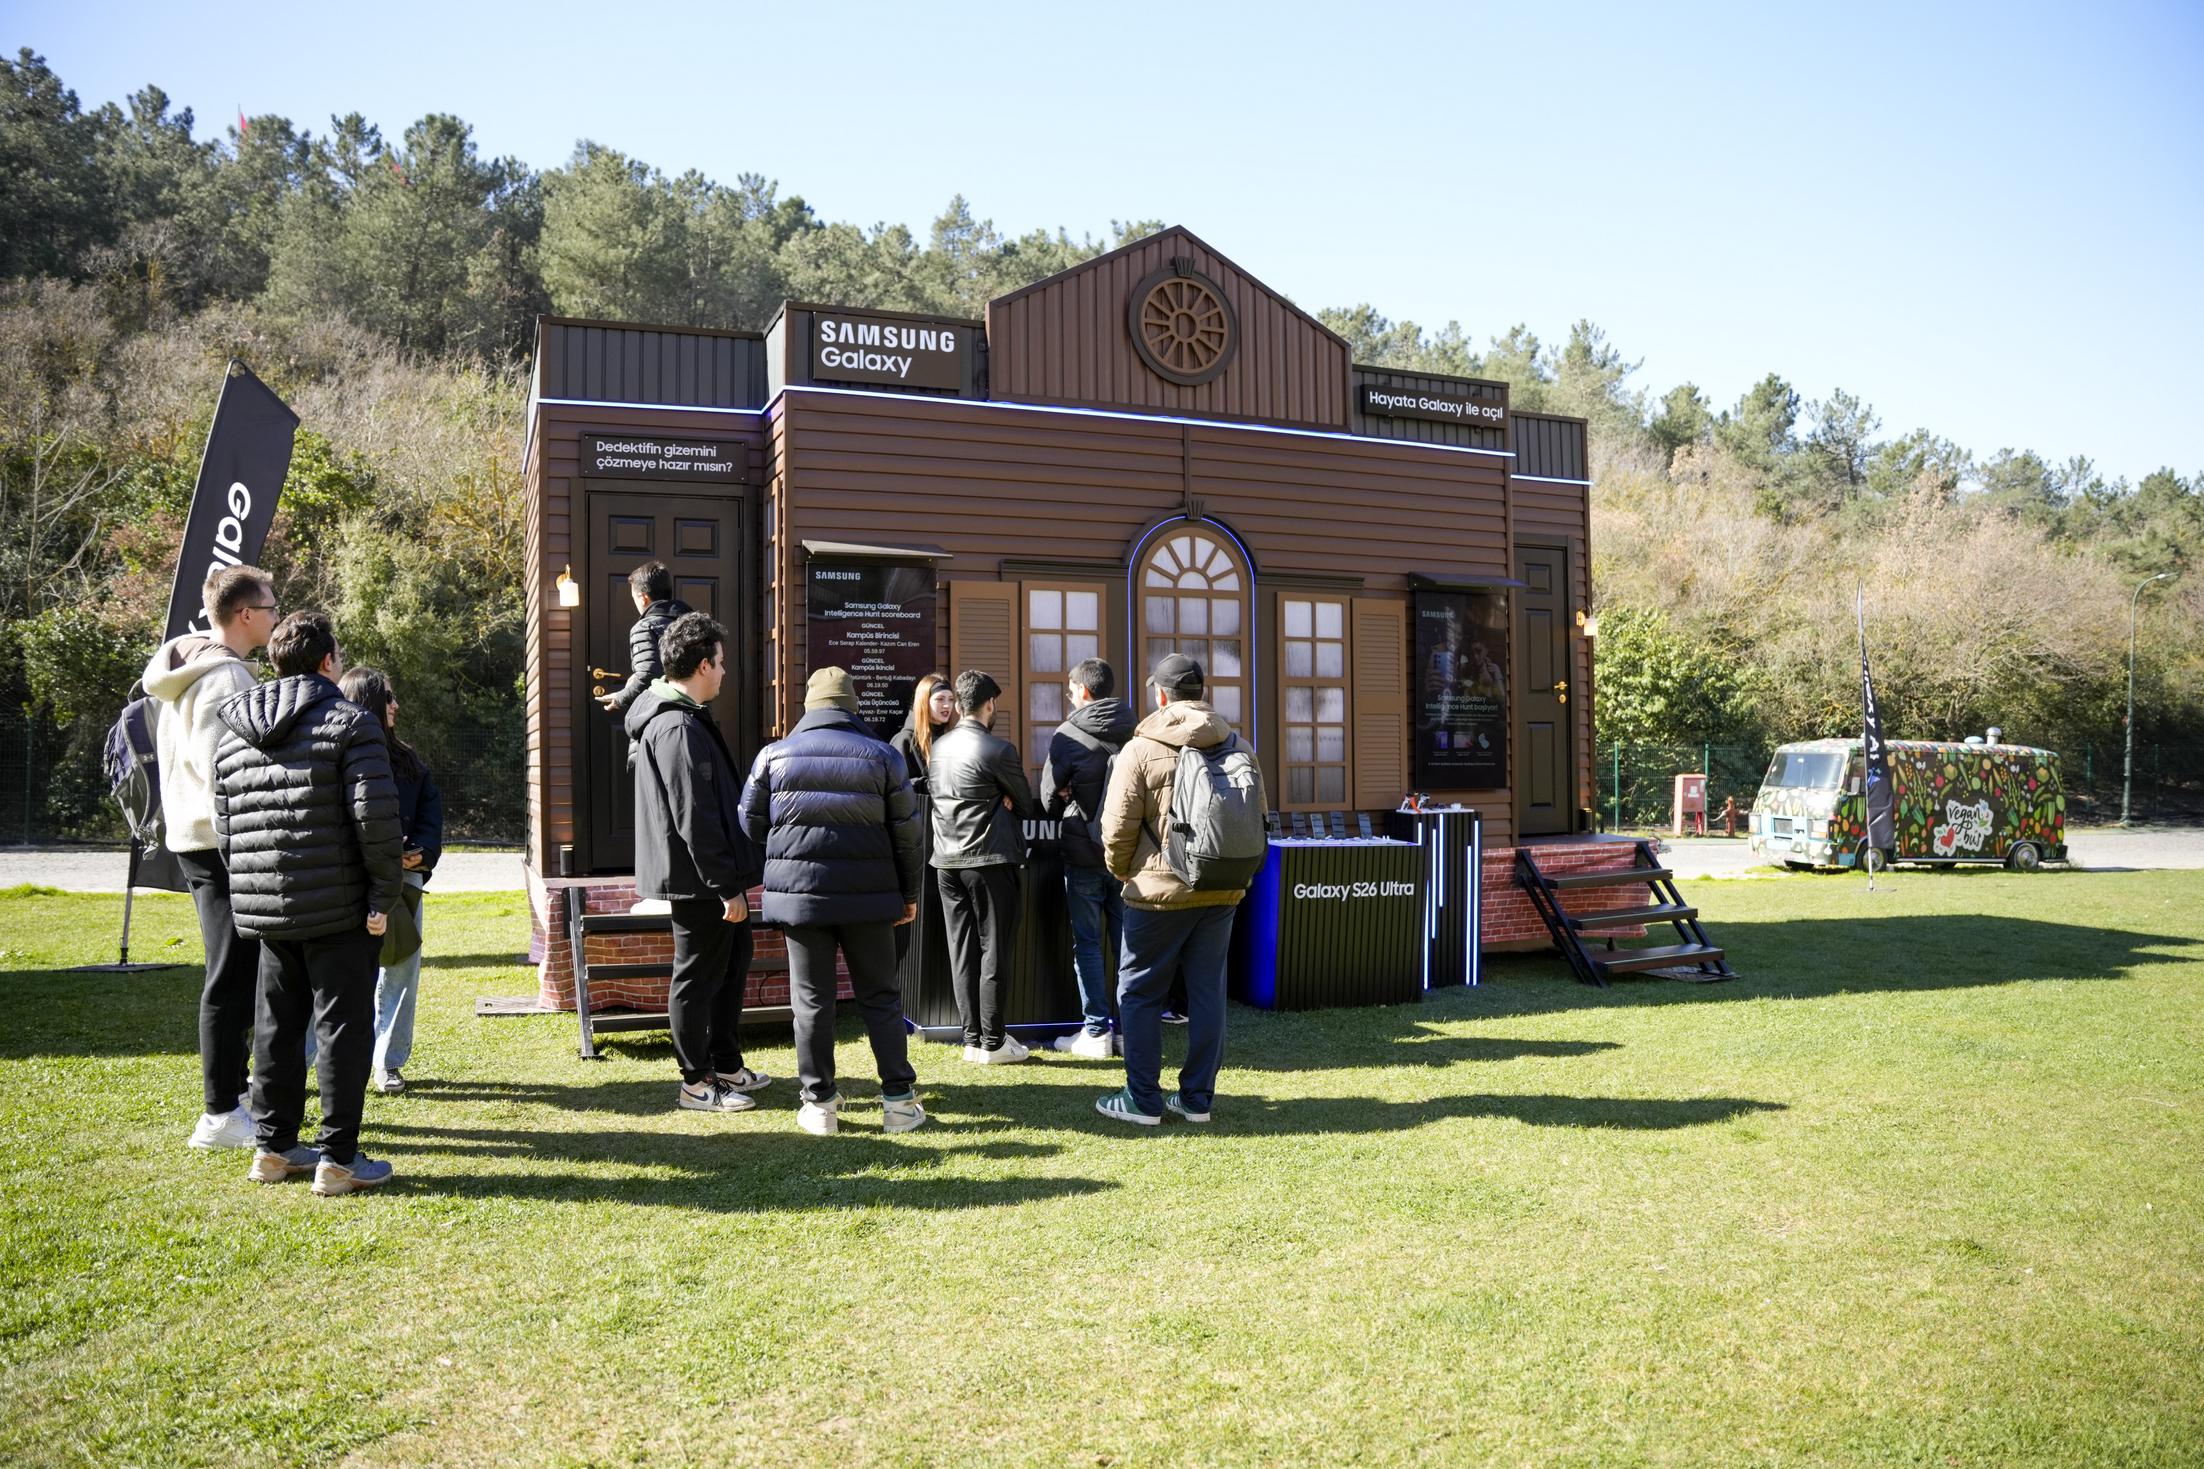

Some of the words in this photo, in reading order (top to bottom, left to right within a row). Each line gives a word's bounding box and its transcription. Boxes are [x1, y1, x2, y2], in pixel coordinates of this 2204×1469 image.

[821, 320, 955, 353] SAMSUNG
[821, 346, 913, 378] Galaxy
[1369, 391, 1416, 409] Hayata
[1419, 397, 1463, 417] Galaxy
[1465, 402, 1479, 416] ile
[1482, 407, 1503, 421] açıl
[596, 441, 661, 455] Dedektifin
[664, 444, 717, 458] gizemini
[596, 456, 656, 472] çözmeye
[659, 459, 691, 471] hazır
[694, 462, 733, 473] mısın?
[815, 571, 861, 581] SAMSUNG
[824, 609, 864, 618] Intelligence
[844, 602, 876, 610] Samsung
[877, 603, 901, 611] Galaxy
[846, 632, 874, 640] Kampüs
[1294, 883, 1350, 901] Galaxy
[1352, 882, 1377, 897] S26
[1380, 881, 1414, 896] Ultra
